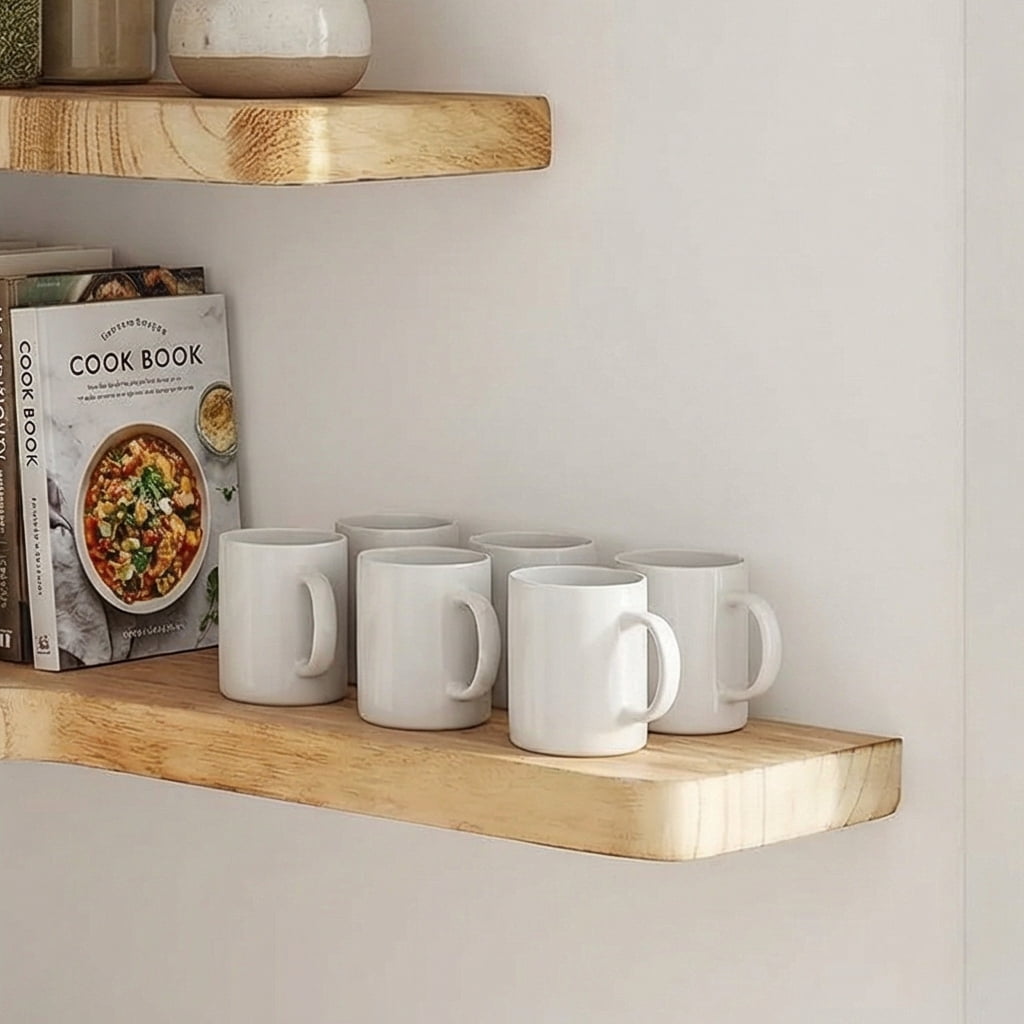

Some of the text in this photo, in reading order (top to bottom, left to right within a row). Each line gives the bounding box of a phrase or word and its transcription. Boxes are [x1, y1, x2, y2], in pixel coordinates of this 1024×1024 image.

[69, 344, 203, 376] COOK BOOK
[19, 340, 39, 467] COOK BOOK
